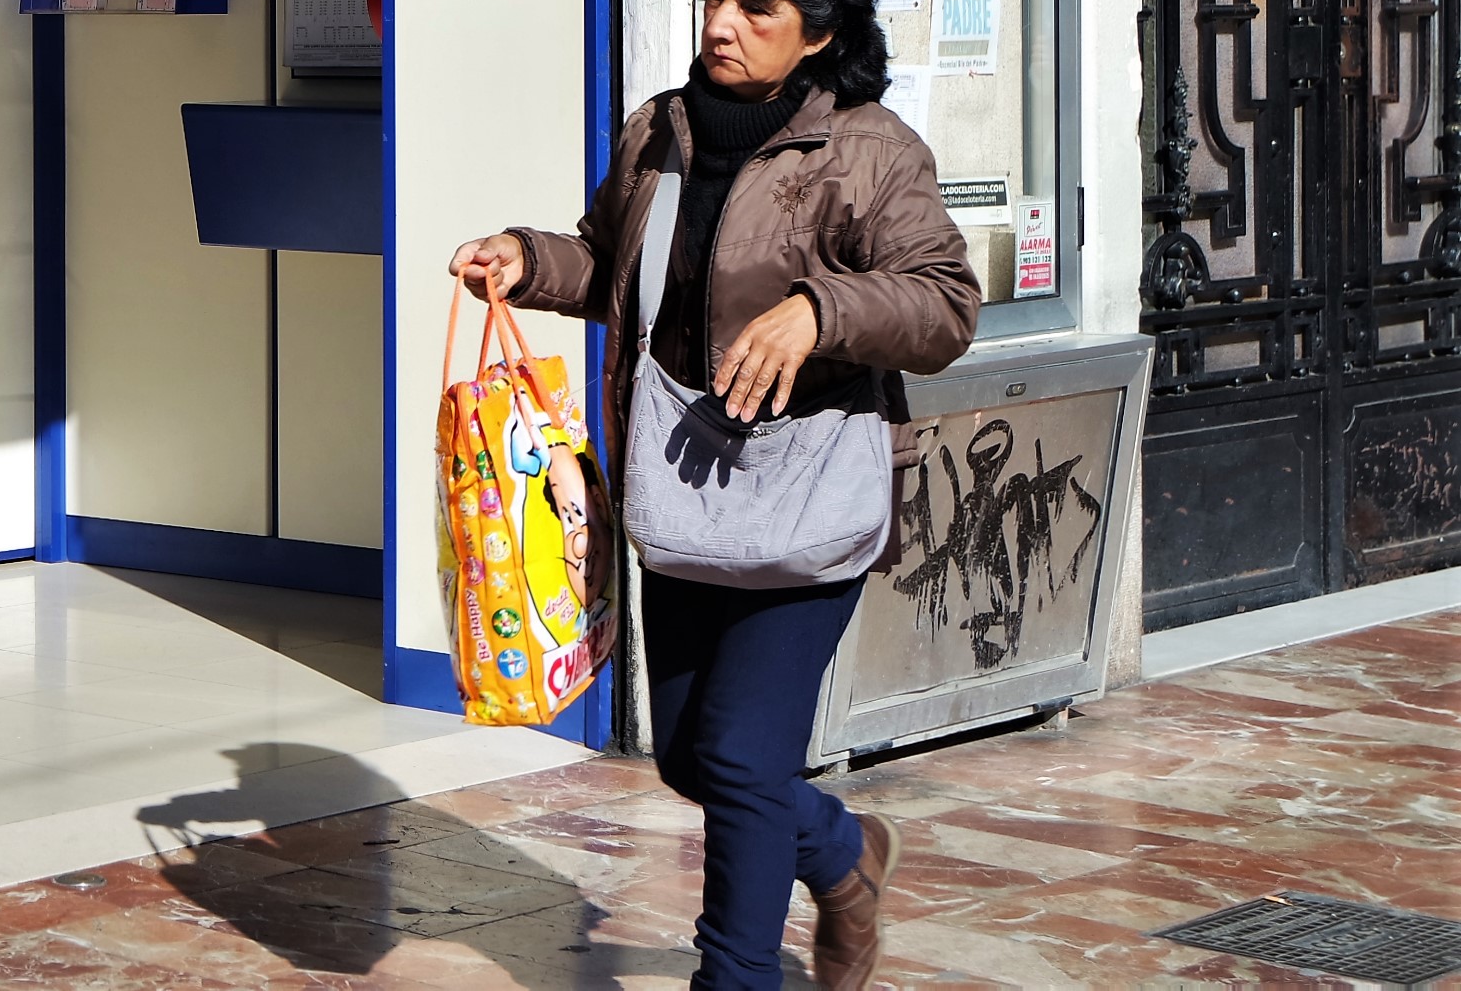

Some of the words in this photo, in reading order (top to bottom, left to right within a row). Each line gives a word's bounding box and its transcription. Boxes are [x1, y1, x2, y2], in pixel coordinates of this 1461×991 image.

[940, 184, 1005, 195] .LADOCELOTERIA.COM
[942, 195, 997, 206] fo@ladoceloteria.com
[1020, 238, 1052, 252] ALARMA
[1032, 256, 1040, 264] 121
[466, 590, 482, 637] Happy
[479, 642, 490, 660] Be
